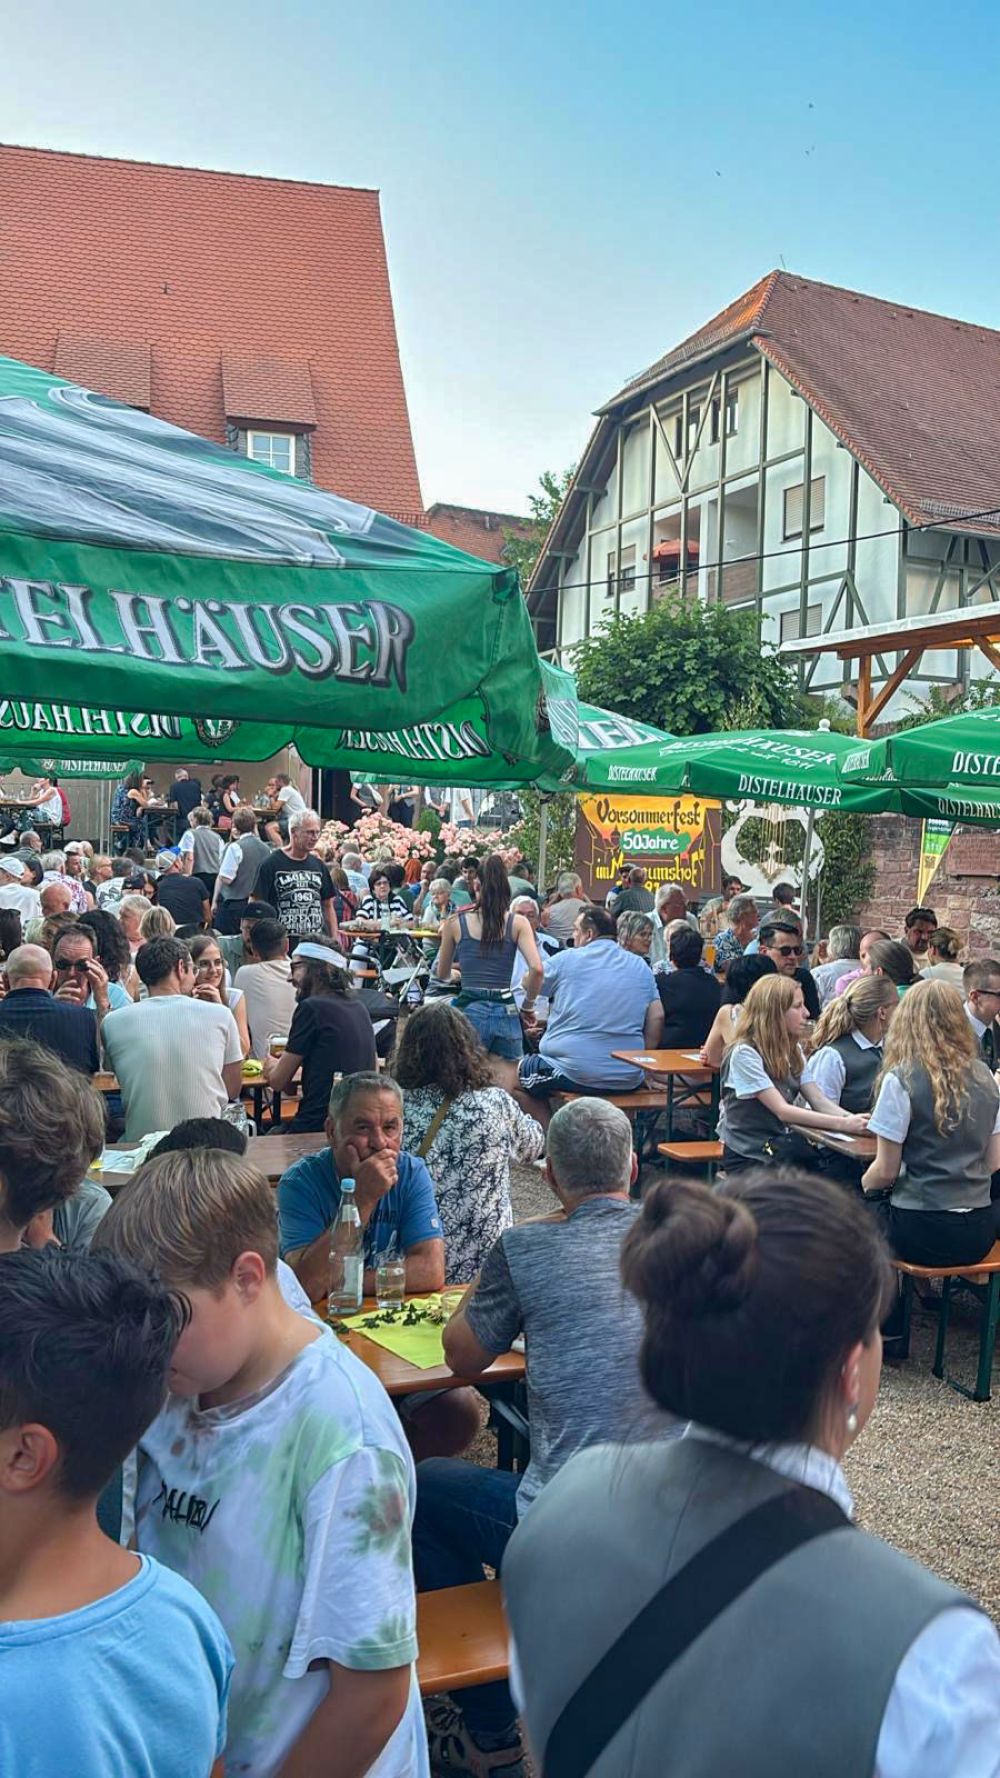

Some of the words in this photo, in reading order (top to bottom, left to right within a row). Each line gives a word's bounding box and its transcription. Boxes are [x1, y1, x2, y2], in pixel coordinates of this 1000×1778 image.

[0, 576, 413, 693] ELHÄUSER
[597, 798, 701, 834] Vorsommerfest
[609, 850, 705, 887] Mumshof
